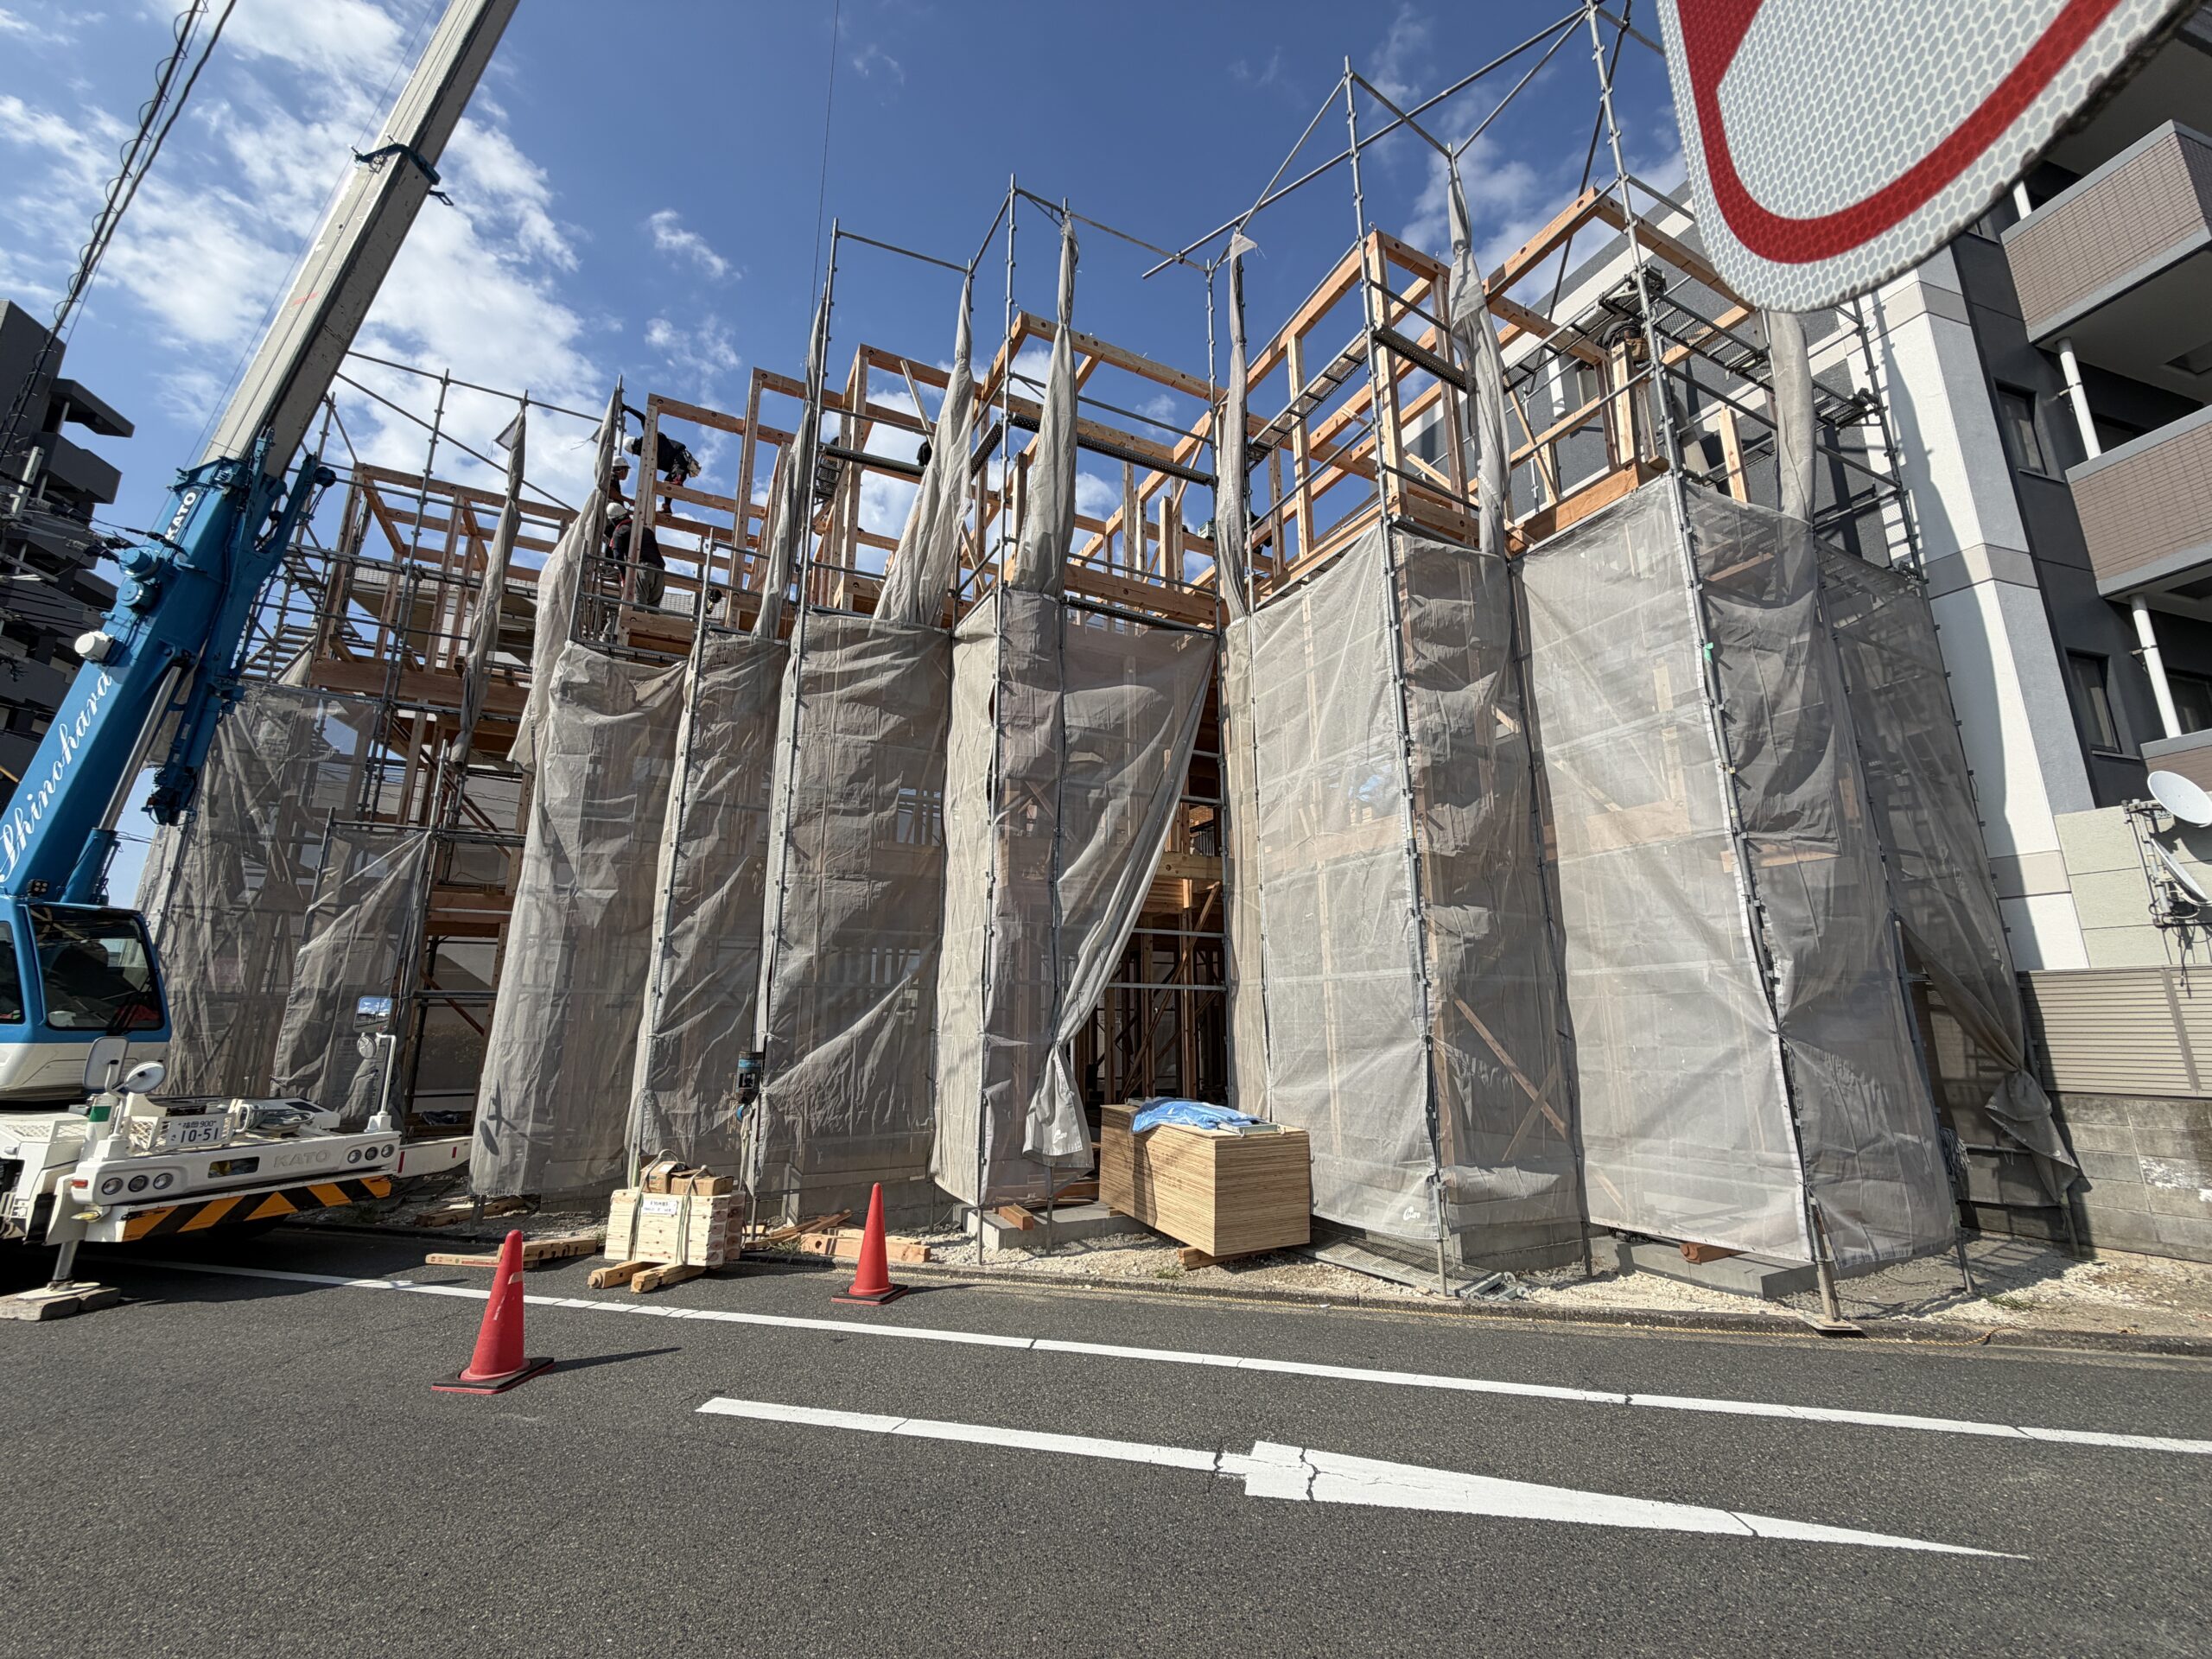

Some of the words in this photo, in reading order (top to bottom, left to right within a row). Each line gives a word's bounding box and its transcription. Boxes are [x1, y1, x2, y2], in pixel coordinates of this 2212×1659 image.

[164, 492, 196, 541] KATO
[0, 671, 112, 883] Shinohara
[180, 1128, 219, 1143] 10-51
[273, 1149, 331, 1169] KATO
